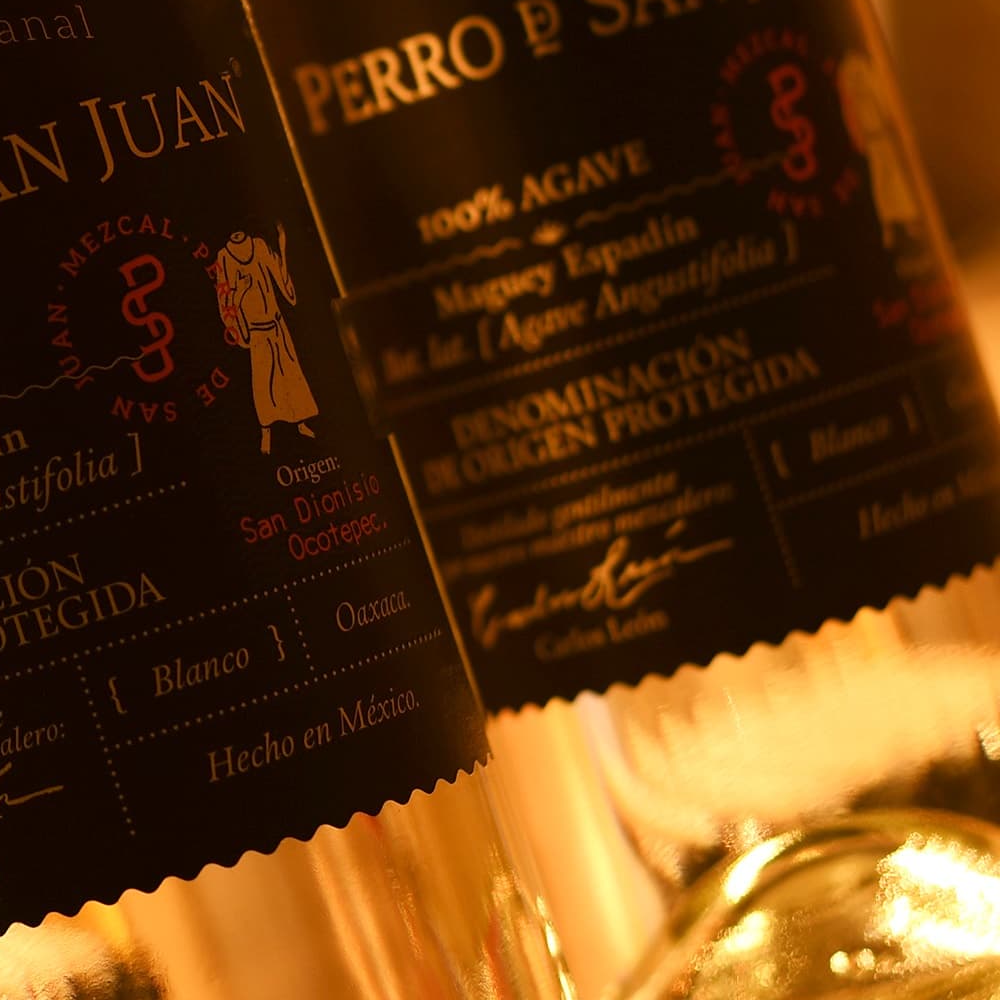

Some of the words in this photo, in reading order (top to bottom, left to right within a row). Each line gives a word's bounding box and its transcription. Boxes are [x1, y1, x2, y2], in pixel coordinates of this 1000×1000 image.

[293, 14, 504, 135] PERRO
[79, 73, 246, 184] JUAN
[417, 183, 515, 244] 100%
[520, 138, 652, 212] AGAVE
[60, 213, 174, 279] MEZCAL
[111, 393, 178, 424] SAN
[275, 455, 341, 488] Origen:
[239, 512, 288, 544] San
[292, 472, 382, 524] Dionisio
[287, 511, 388, 561] Ocotepec.
[335, 590, 412, 632] Oaxaca.
[151, 647, 251, 698] Blanco
[207, 731, 295, 784] Hecho
[303, 722, 333, 750] en
[337, 687, 421, 738] México.
